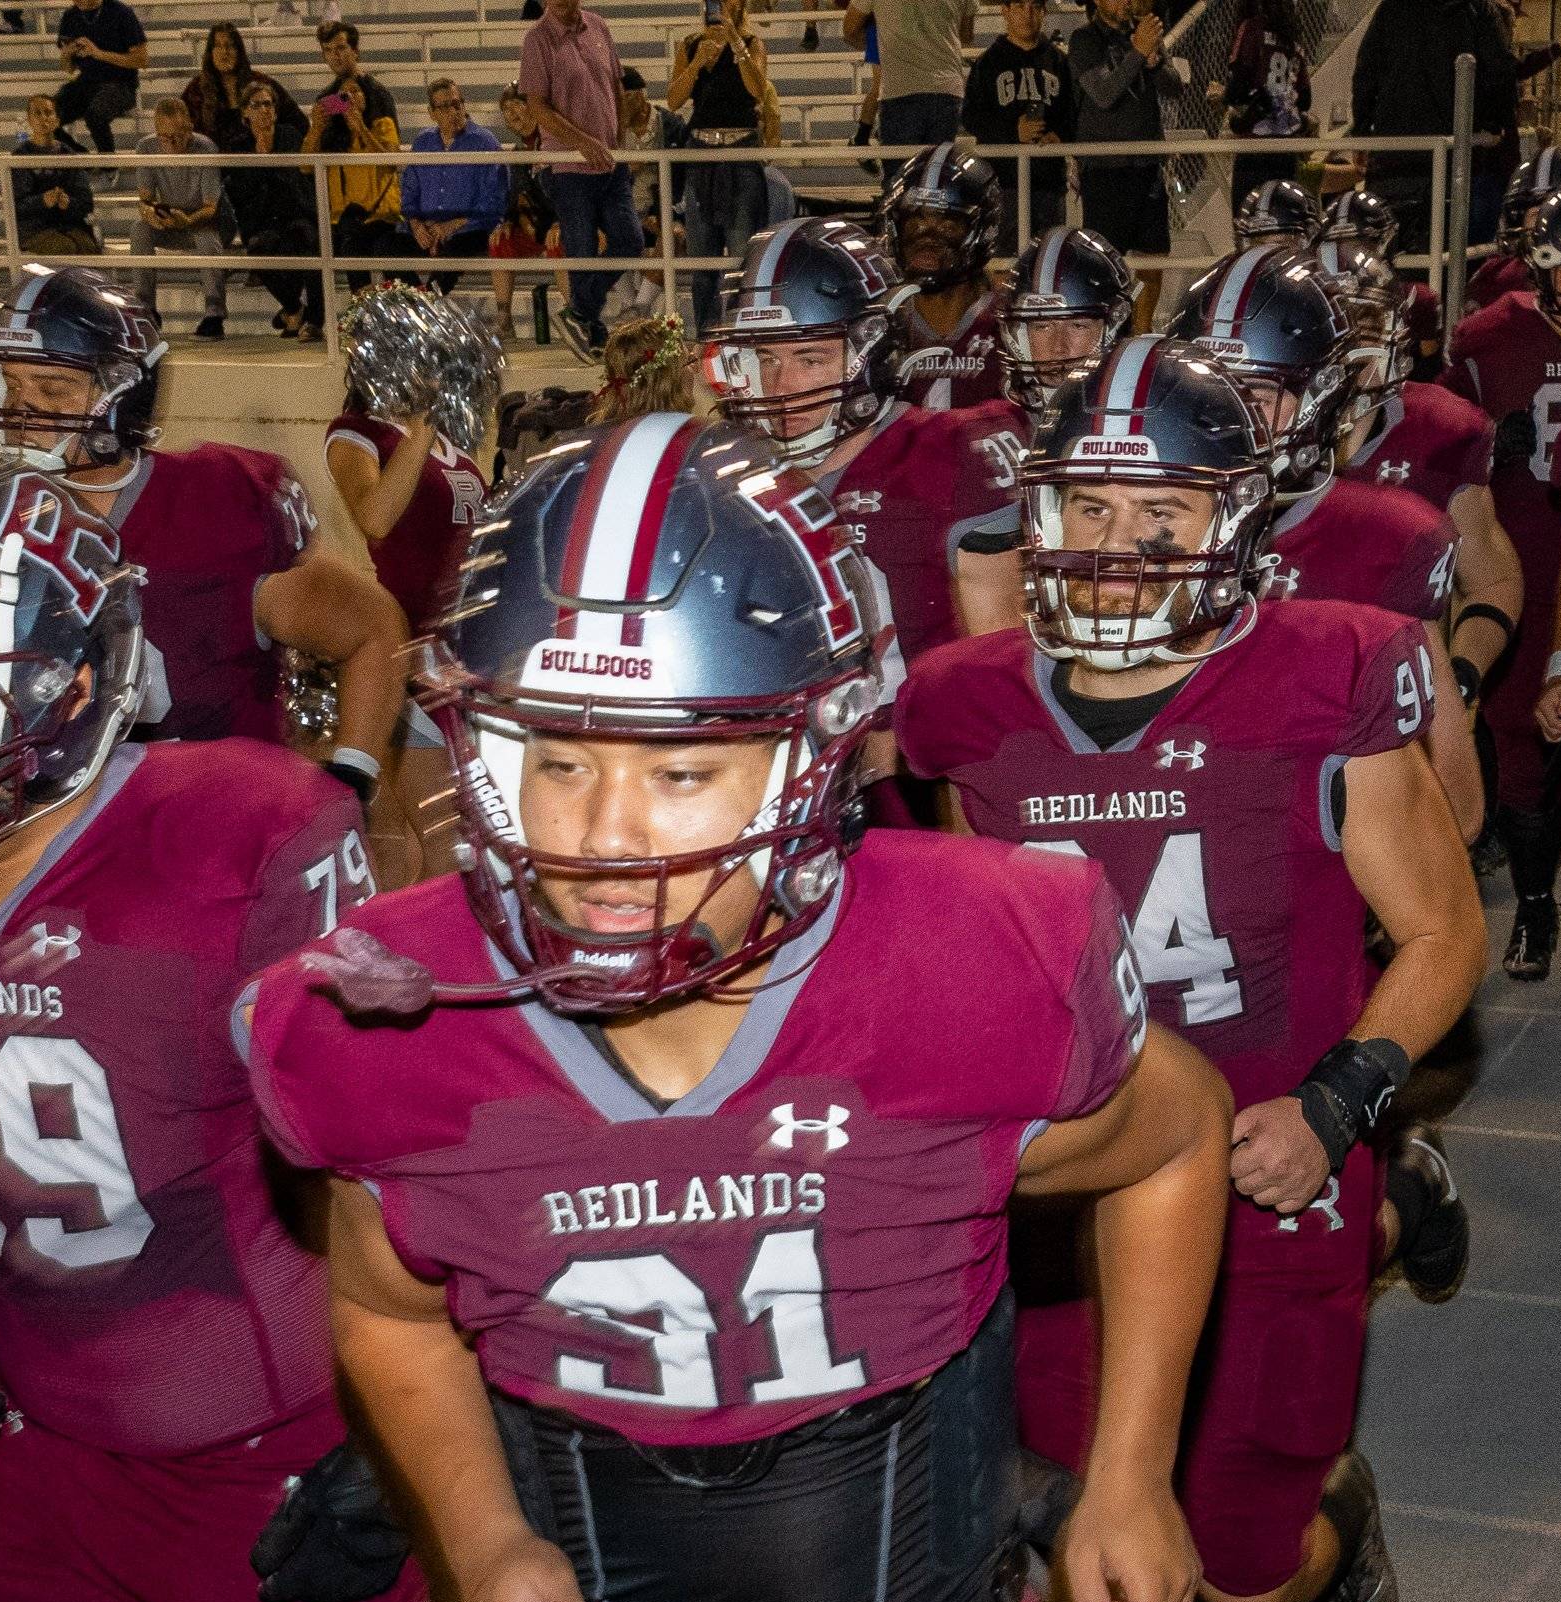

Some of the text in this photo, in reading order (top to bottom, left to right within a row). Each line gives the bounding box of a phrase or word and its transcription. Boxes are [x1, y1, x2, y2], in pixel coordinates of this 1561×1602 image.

[996, 68, 1061, 107] GAP
[916, 356, 986, 371] EDLANDS
[1081, 441, 1149, 457] BULLDOGS
[441, 468, 489, 525] R
[1090, 626, 1124, 637] Rddell
[540, 647, 653, 681] BULLDOGS
[1026, 789, 1187, 824] REDLANDS
[303, 828, 378, 939] 79
[542, 1171, 827, 1237] REDLANDS
[545, 1228, 868, 1409] 91
